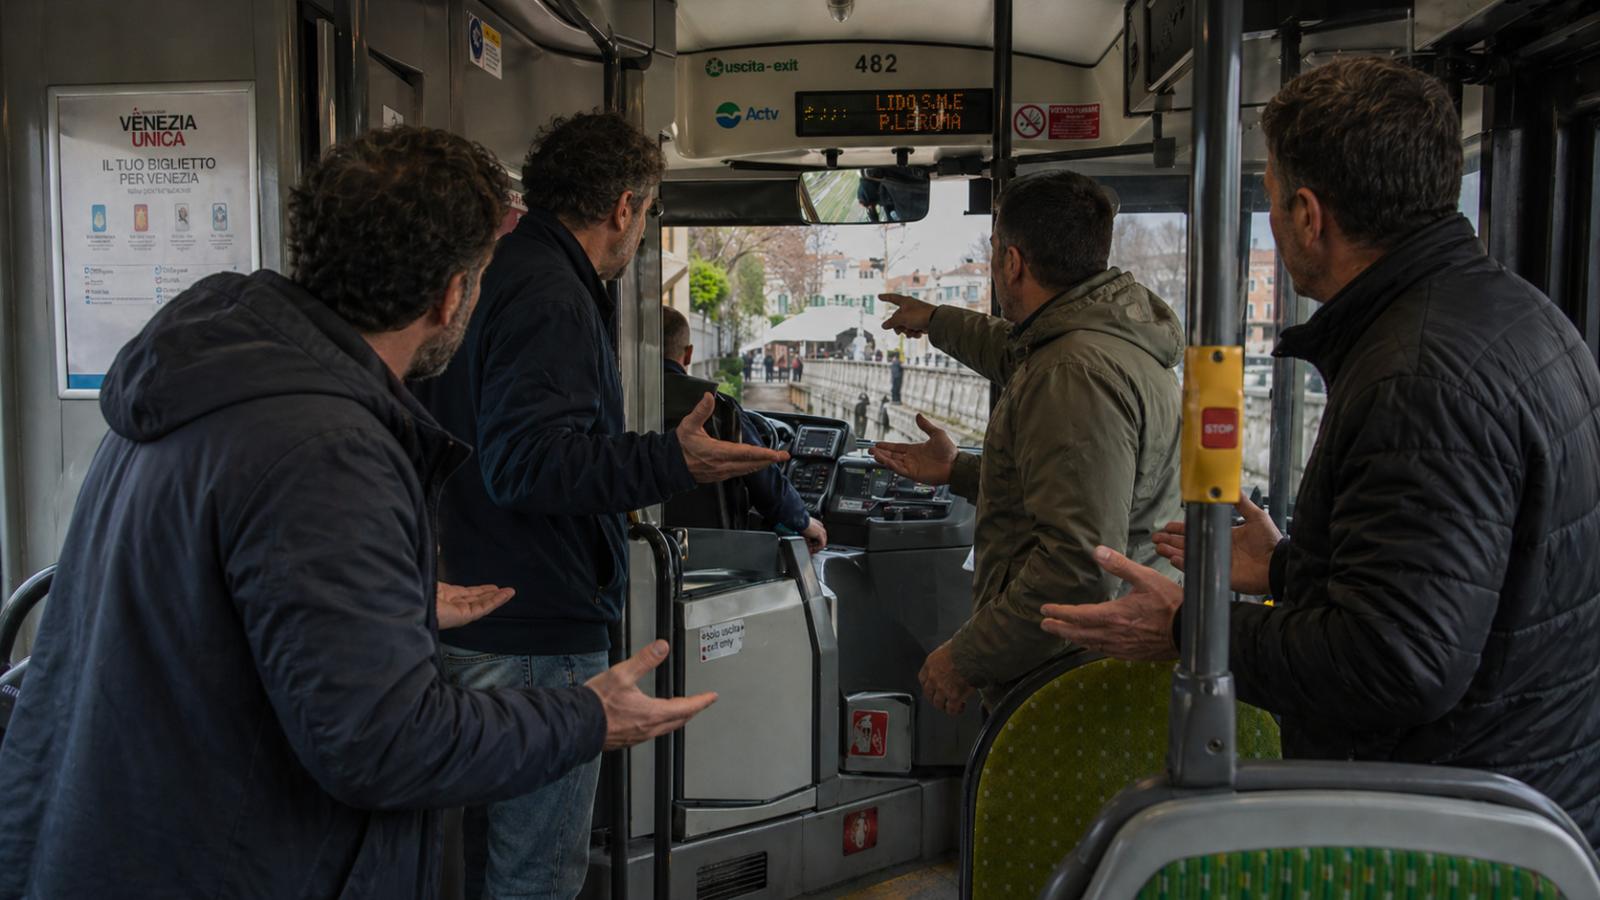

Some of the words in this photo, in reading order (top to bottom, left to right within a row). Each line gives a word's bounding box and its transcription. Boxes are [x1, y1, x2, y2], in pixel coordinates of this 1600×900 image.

[855, 54, 897, 73] 482
[876, 94, 916, 111] LIDO
[746, 106, 779, 121] Actv
[120, 114, 198, 131] VENEZIA
[132, 131, 186, 148] UNICA
[102, 159, 114, 171] IL
[116, 158, 145, 171] TUO
[148, 157, 216, 170] BIGLIETTO
[120, 173, 145, 185] PER
[146, 173, 200, 184] VENEZIA
[1204, 423, 1234, 434] STOP
